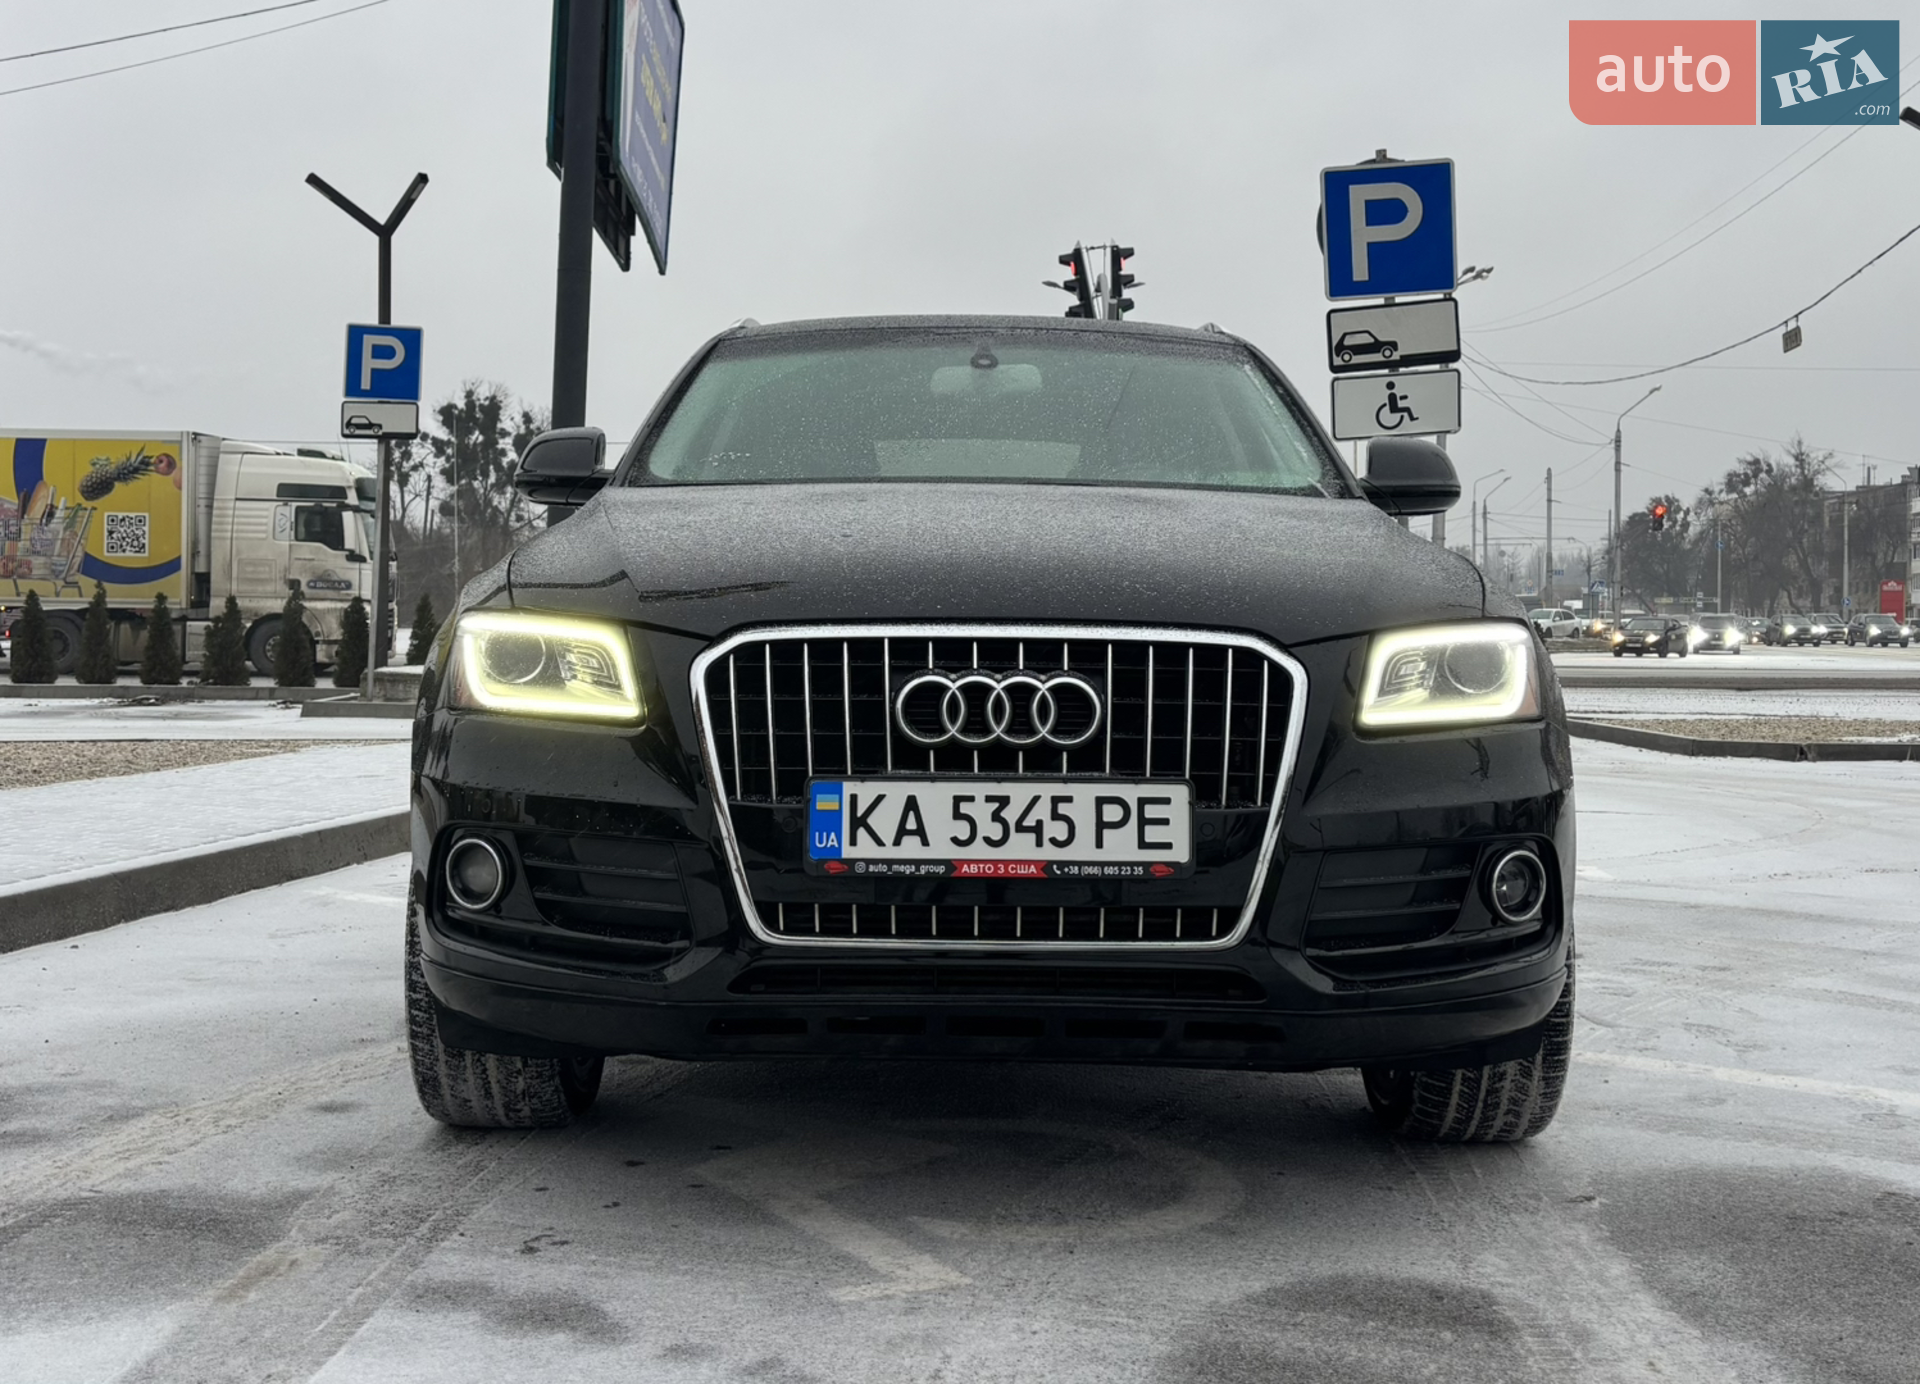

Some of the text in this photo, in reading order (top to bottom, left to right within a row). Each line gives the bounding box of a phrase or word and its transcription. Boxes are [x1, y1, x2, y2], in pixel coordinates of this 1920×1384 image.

[1349, 182, 1423, 281] P
[361, 334, 405, 390] P
[849, 793, 1174, 850] KA 5345 PE
[815, 832, 839, 848] UA
[868, 862, 946, 875] auto_mega_group
[961, 863, 994, 874] АВТО
[1008, 864, 1037, 874] США
[1063, 864, 1144, 876] +38 (066) 605 23 35
